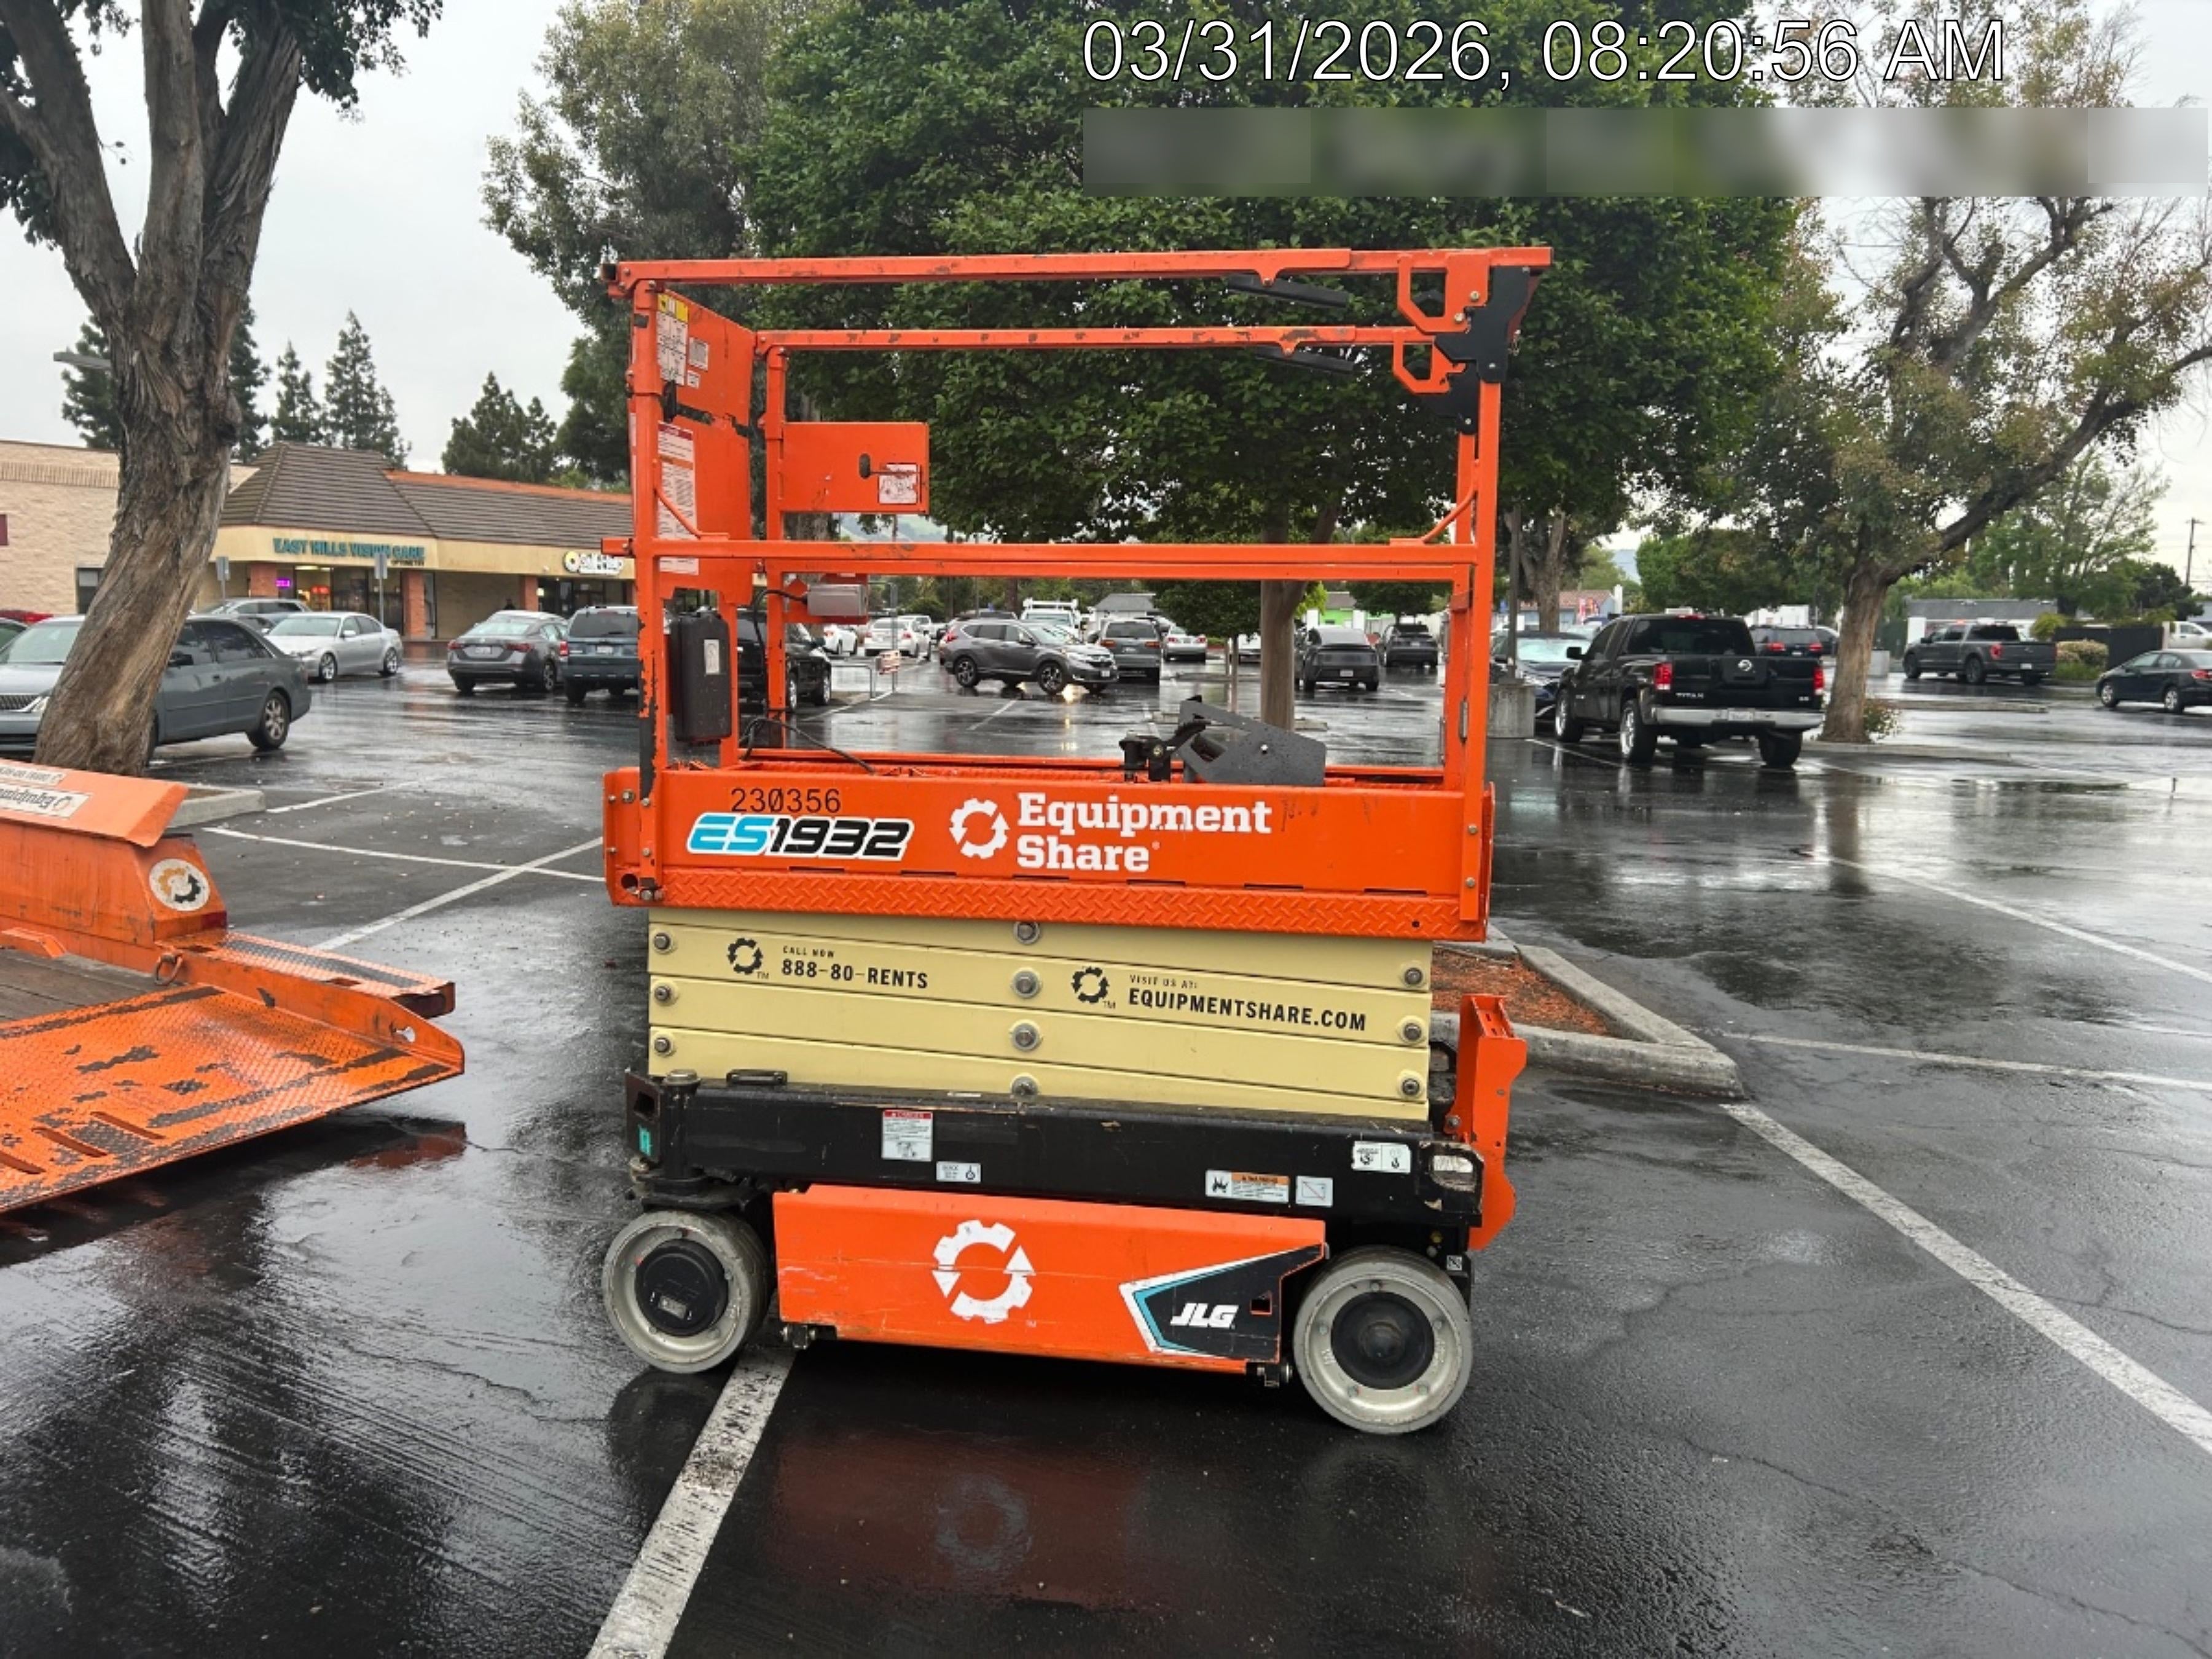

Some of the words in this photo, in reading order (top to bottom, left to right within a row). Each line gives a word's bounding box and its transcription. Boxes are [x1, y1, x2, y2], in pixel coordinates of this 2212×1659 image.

[273, 538, 308, 554] EAST
[309, 539, 347, 557] HILLS
[392, 545, 425, 562] CARE
[730, 788, 841, 814] 230356
[1017, 792, 1272, 837] Equipment
[687, 814, 913, 859] ES1932
[1017, 834, 1150, 872] Share
[782, 945, 807, 955] CALL
[812, 948, 834, 959] NOW
[782, 959, 928, 989] 888-80-RENTS
[1129, 974, 1158, 985] VISIT
[1163, 978, 1177, 987] US
[1128, 987, 1367, 1032] EQUIPMENTSHARE.COM
[1169, 1302, 1239, 1328] JLG
